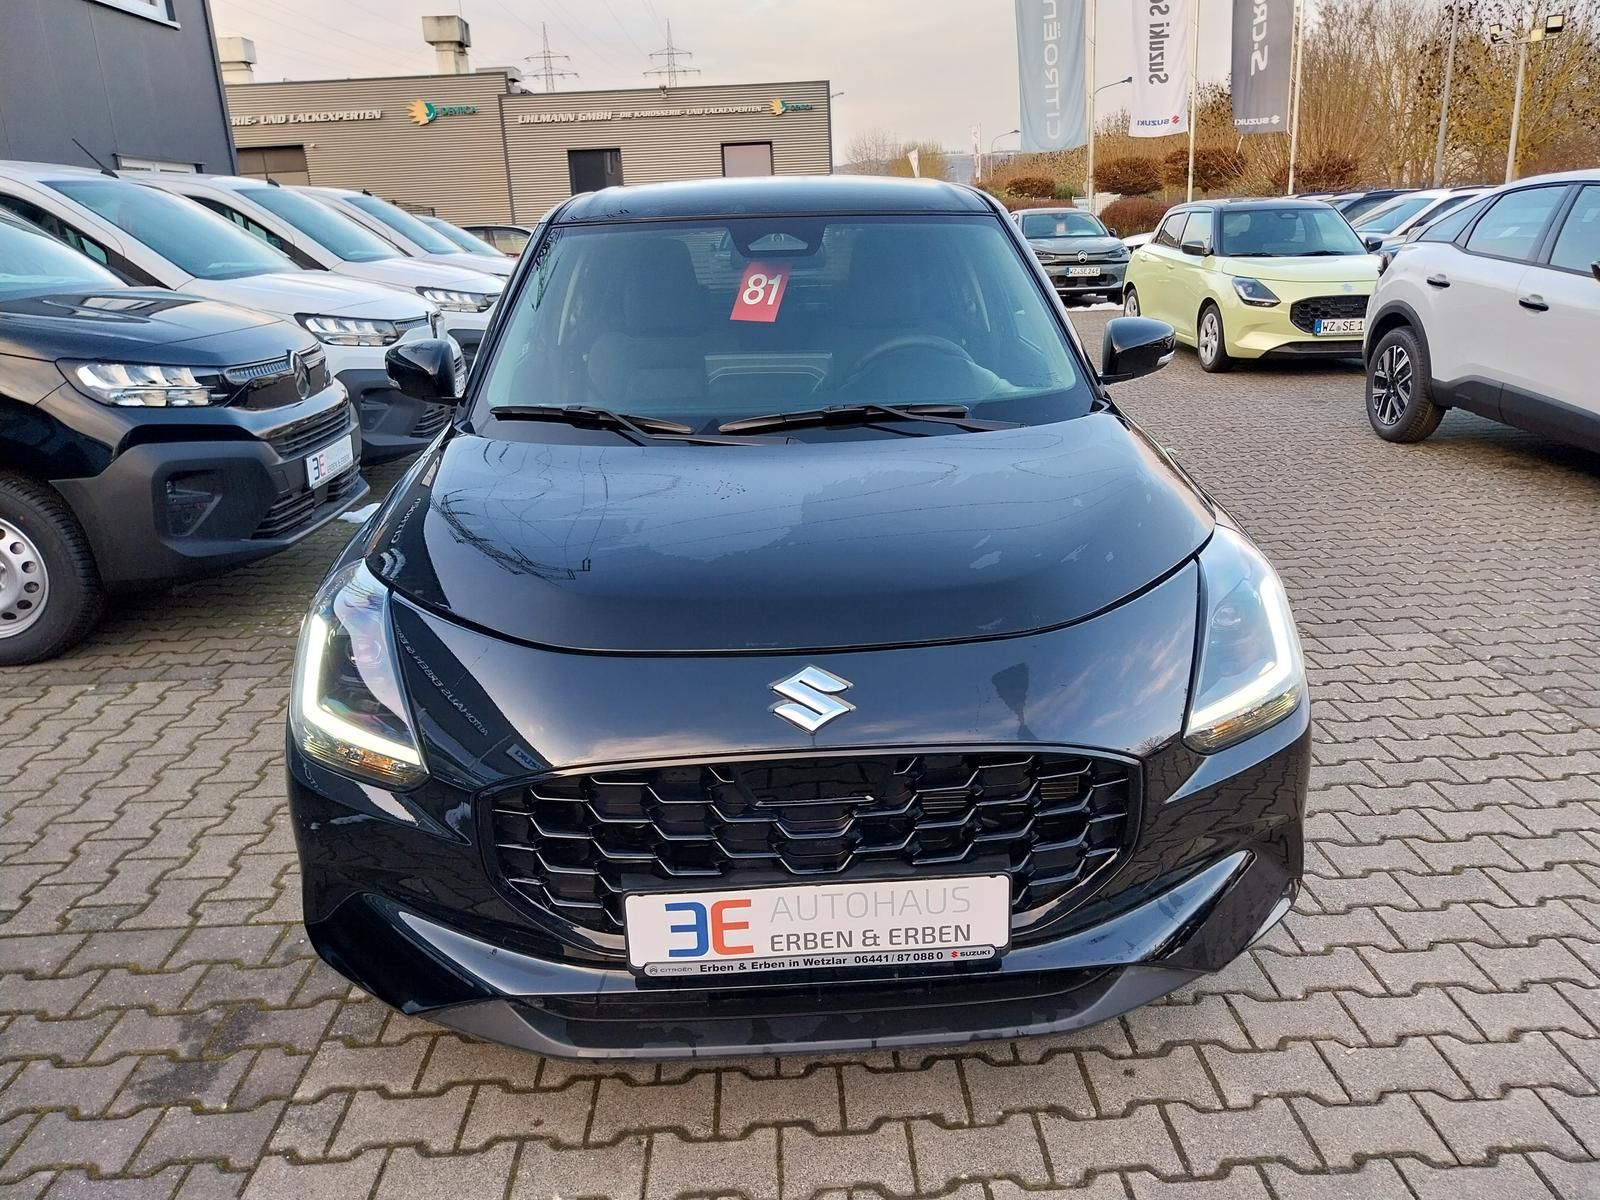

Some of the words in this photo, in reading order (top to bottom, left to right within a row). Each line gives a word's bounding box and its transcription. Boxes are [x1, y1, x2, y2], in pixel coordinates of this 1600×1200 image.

[260, 114, 288, 125] UND
[289, 110, 382, 123] LACKEXPERTEN
[518, 113, 575, 124] UHLMANN
[742, 273, 782, 305] 81
[1322, 321, 1335, 332] WZ
[1342, 321, 1355, 331] SE
[770, 886, 970, 923] AUTOHAUS
[770, 930, 853, 953] ERBEN
[862, 929, 880, 948] &
[888, 924, 971, 946] ERBEN
[700, 964, 734, 973] Erben
[738, 962, 747, 971] &
[752, 961, 785, 970] Erben
[789, 959, 800, 968] in
[803, 956, 848, 967] Wetzlar
